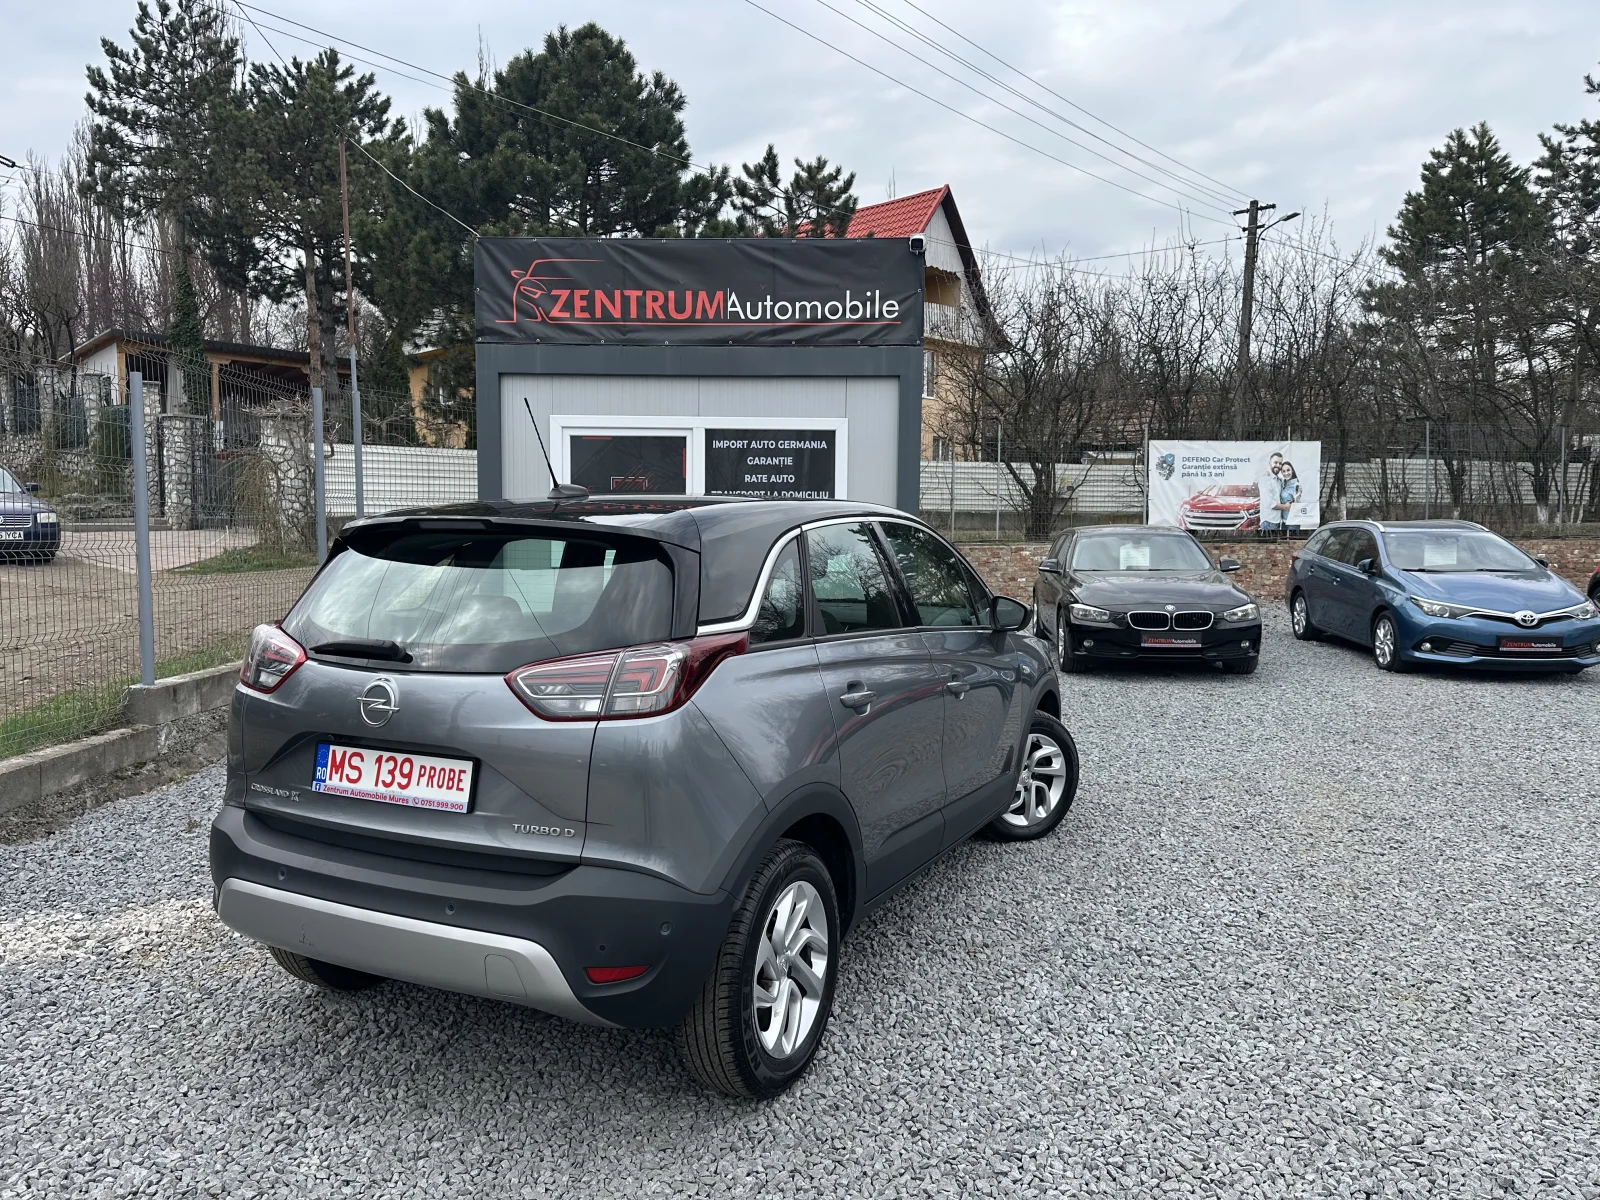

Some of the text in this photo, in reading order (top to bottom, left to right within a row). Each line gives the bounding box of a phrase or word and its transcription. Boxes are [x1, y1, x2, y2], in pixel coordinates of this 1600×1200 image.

[549, 289, 900, 320] ZENTRUM Automobile
[712, 440, 828, 449] IMPORT AUTO GERMANIA
[744, 474, 796, 483] RATE AUTO
[781, 490, 829, 499] DOMICILIU
[316, 766, 328, 780] RO
[328, 749, 467, 792] MS 139 PROBE
[323, 784, 349, 796] Zentrum
[350, 788, 388, 802] Automobile
[420, 800, 464, 811] 0751.999.900
[512, 823, 576, 838] TURBO D
